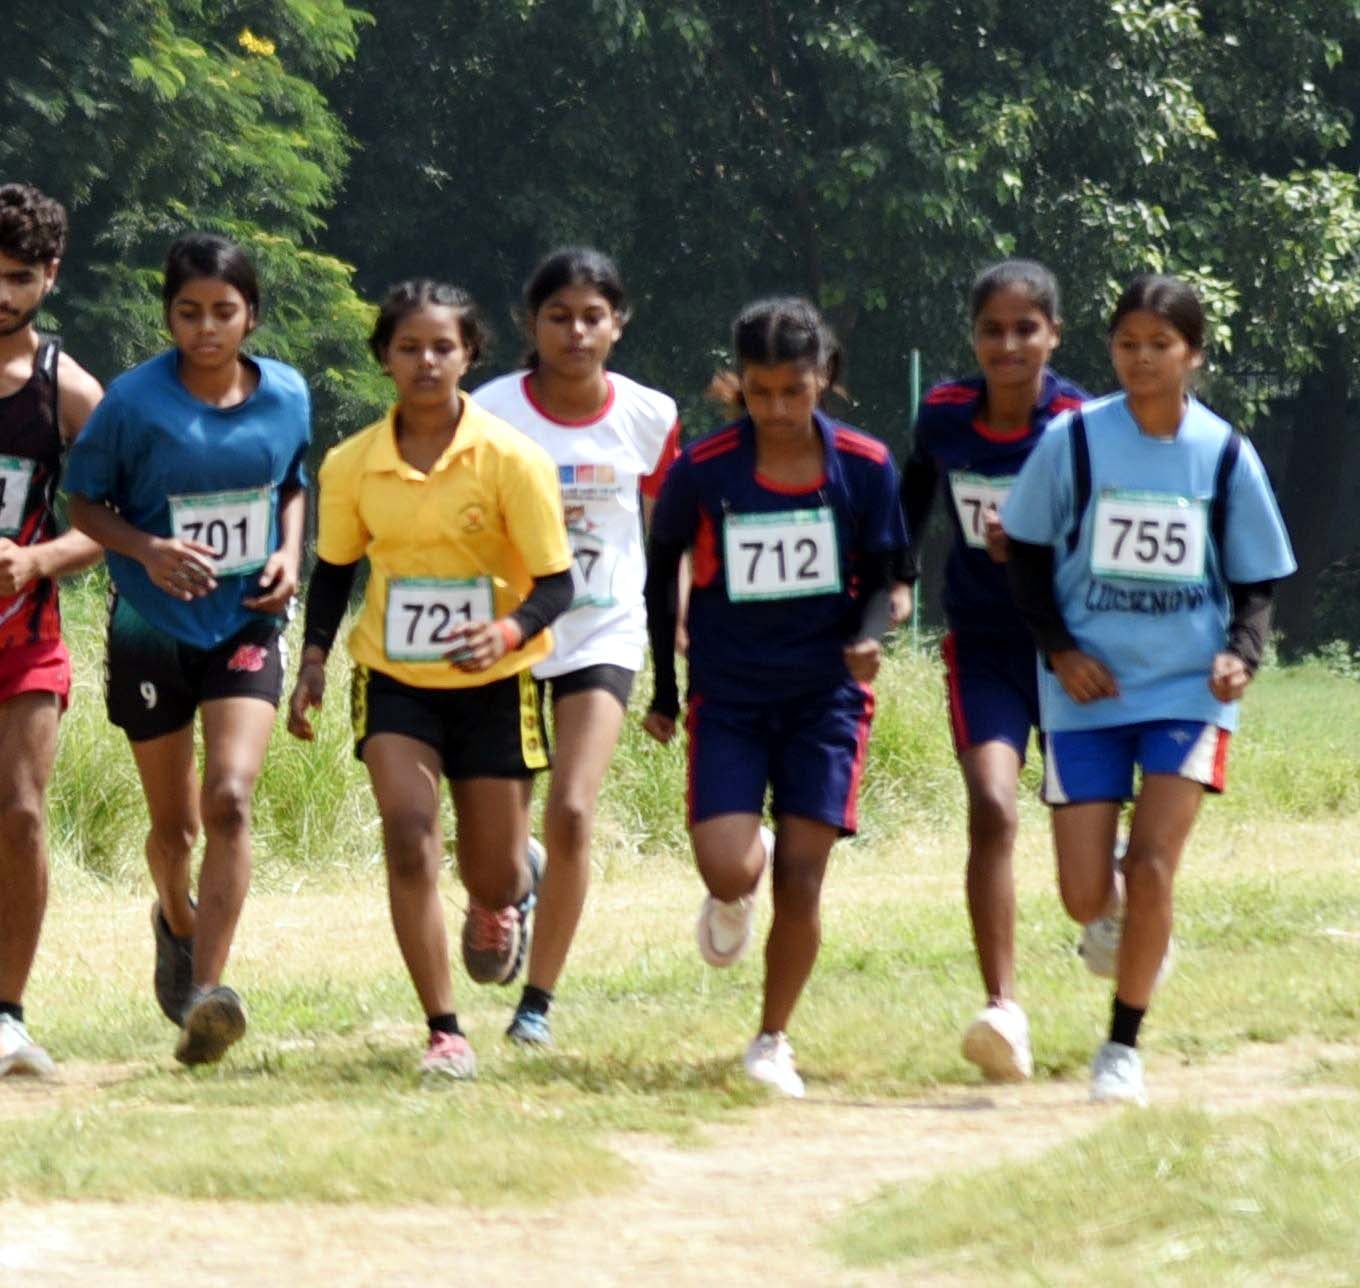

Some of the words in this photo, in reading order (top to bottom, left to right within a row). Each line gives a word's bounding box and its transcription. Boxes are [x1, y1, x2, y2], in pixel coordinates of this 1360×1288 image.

[183, 518, 248, 561] 701
[961, 499, 997, 537] 7
[740, 538, 819, 584] 712
[1109, 518, 1187, 565] 755
[140, 682, 157, 708] 9
